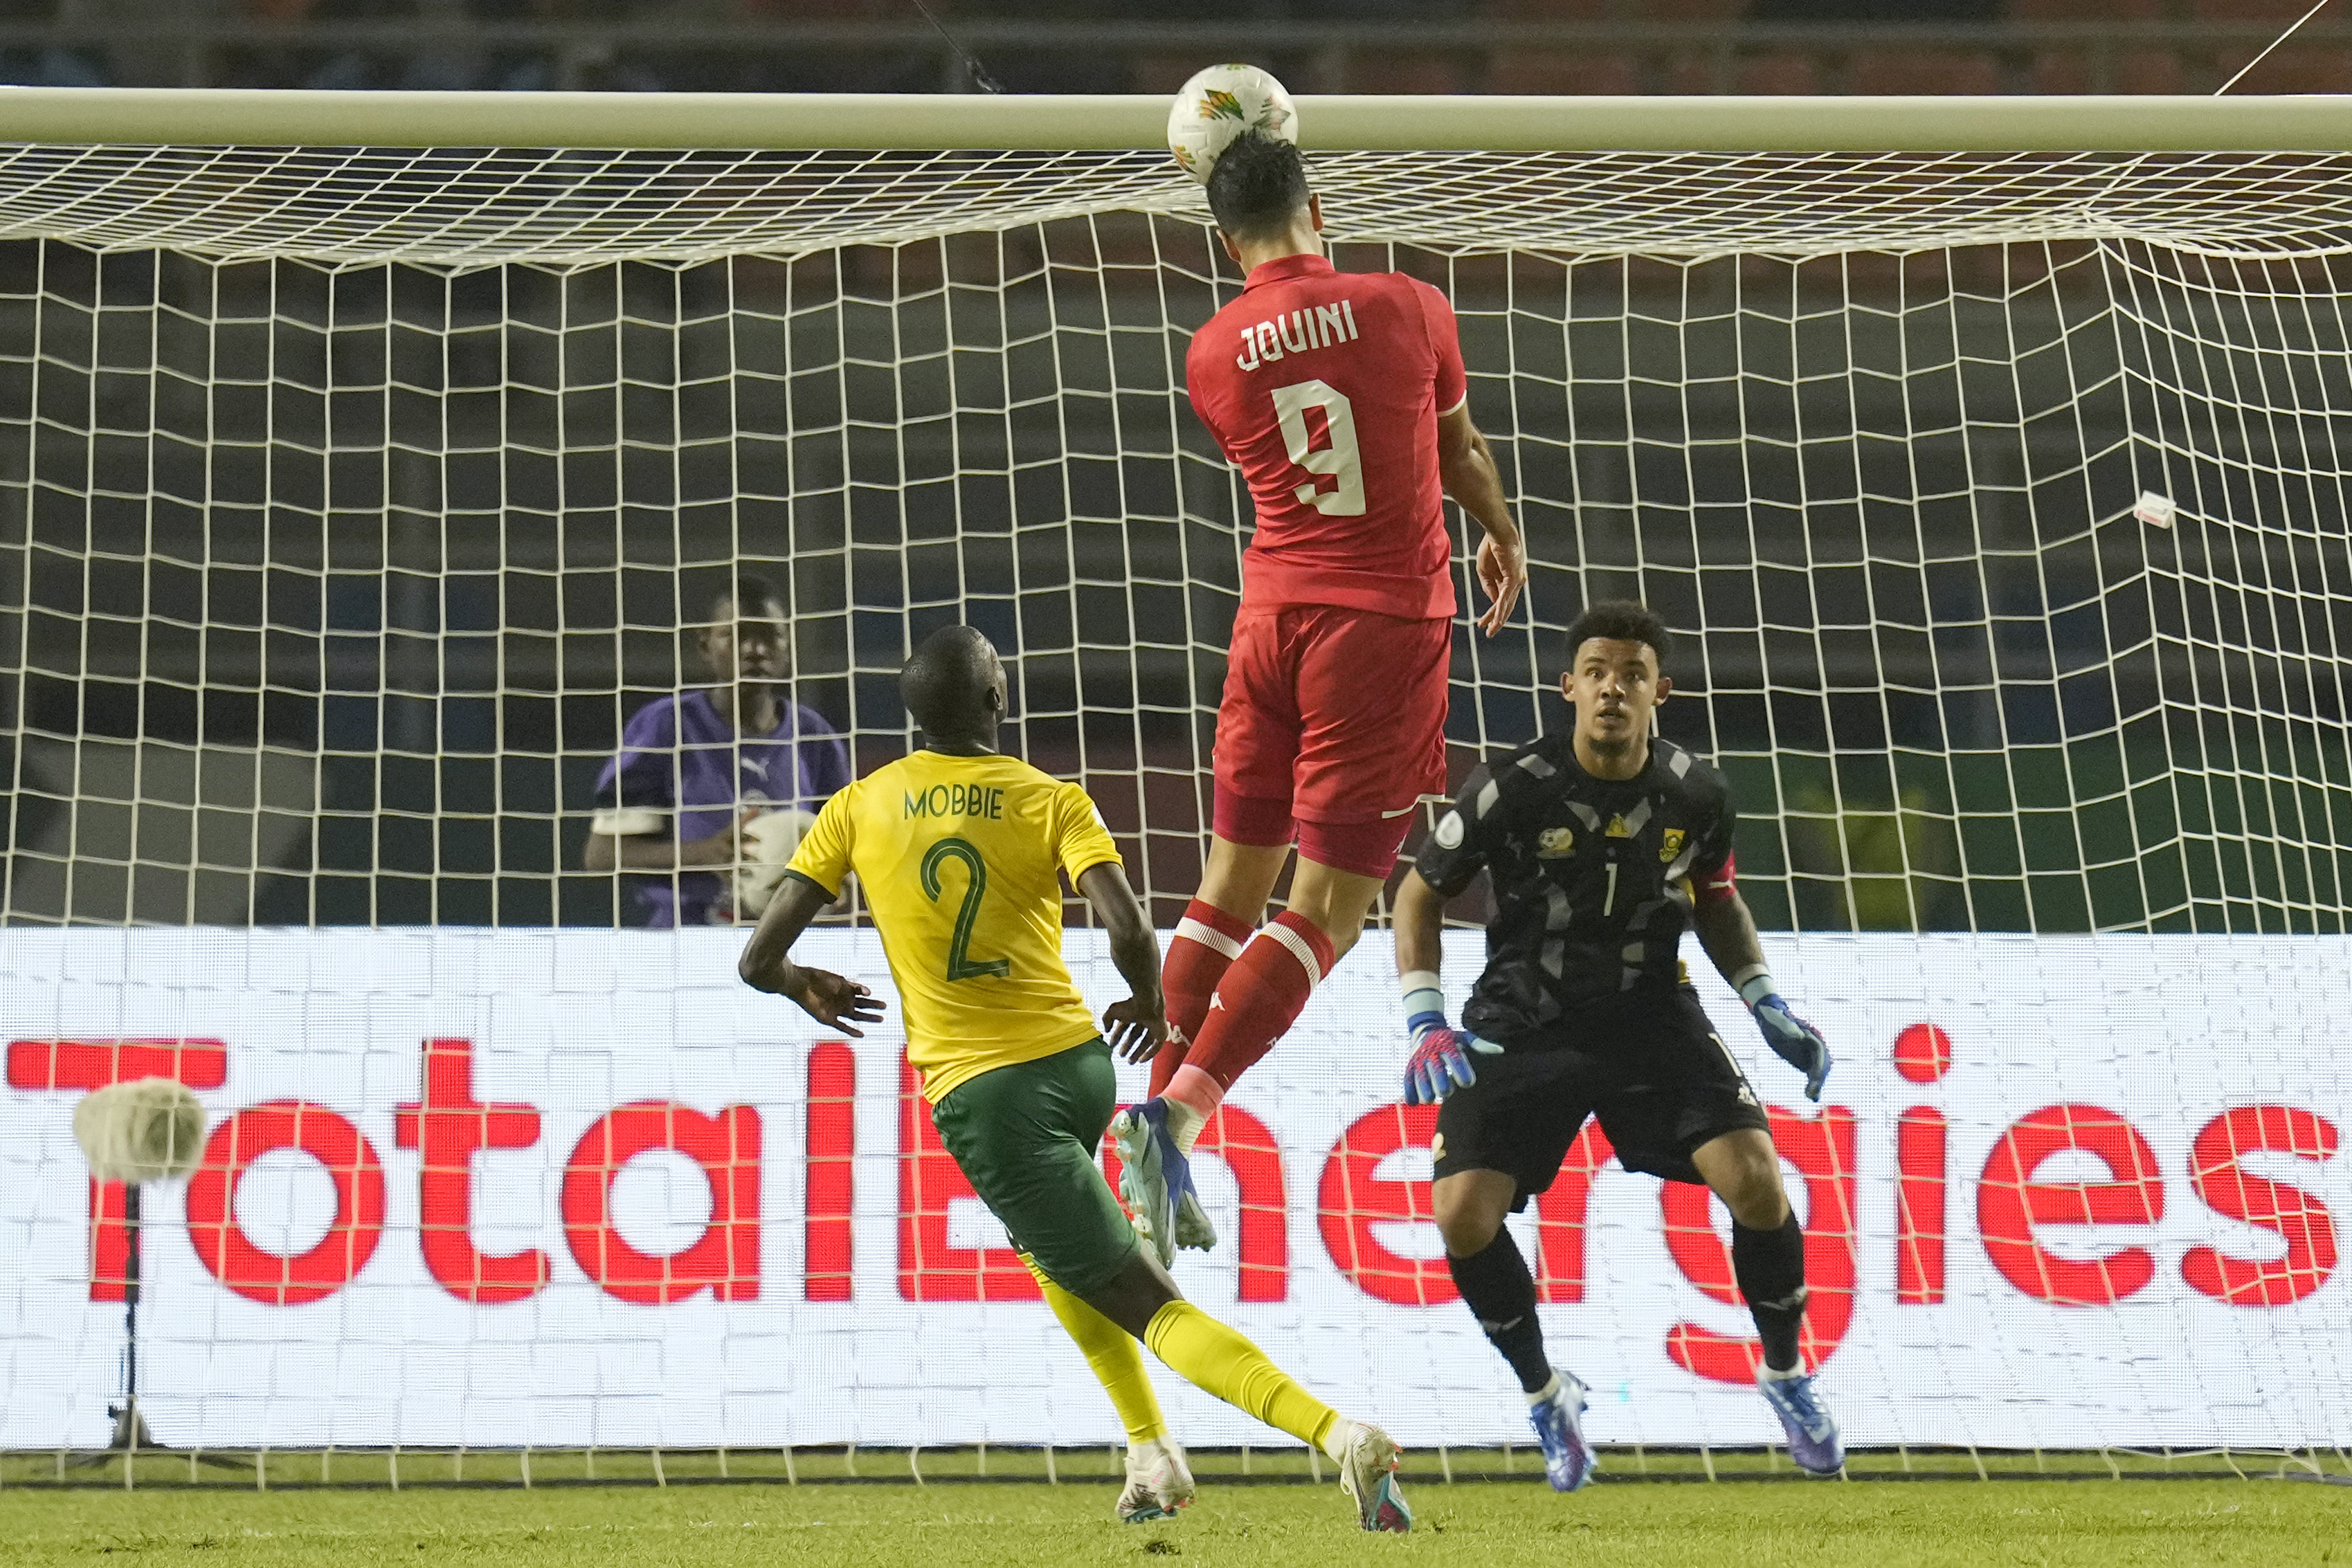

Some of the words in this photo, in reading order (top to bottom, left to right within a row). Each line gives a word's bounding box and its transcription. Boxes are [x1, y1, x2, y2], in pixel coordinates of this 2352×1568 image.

[1237, 300, 1359, 371] JOUINI
[1270, 379, 1367, 517] 9
[904, 784, 1005, 821] MOBBIE
[920, 837, 1011, 982] 2
[1604, 863, 1618, 916] 1
